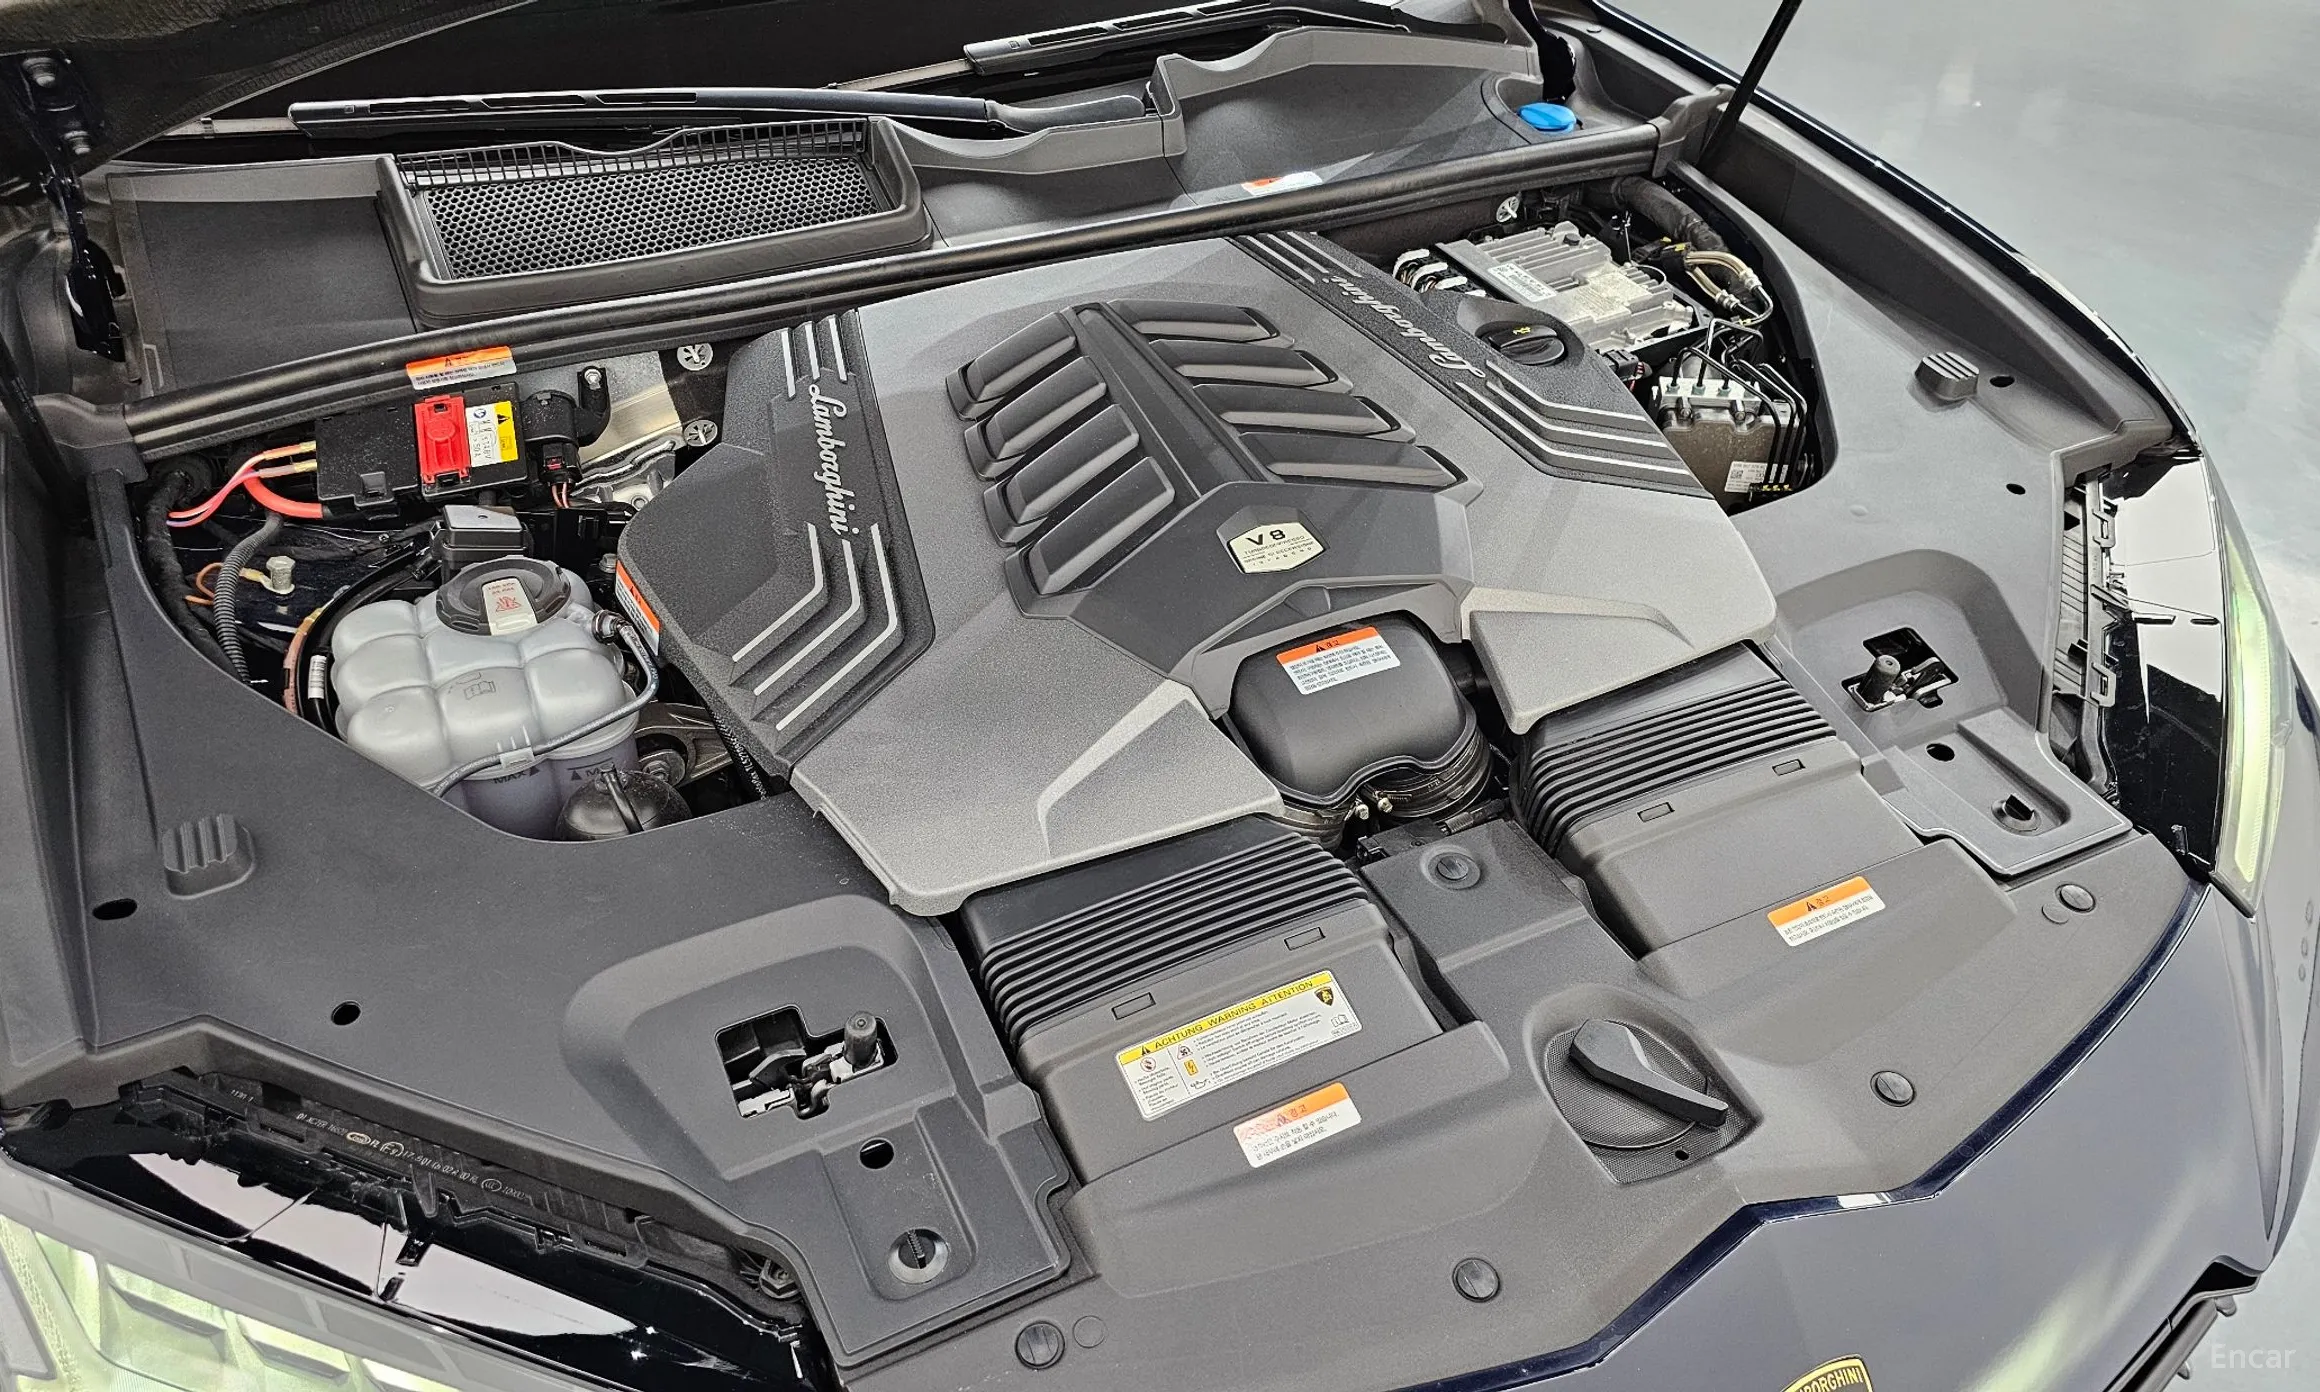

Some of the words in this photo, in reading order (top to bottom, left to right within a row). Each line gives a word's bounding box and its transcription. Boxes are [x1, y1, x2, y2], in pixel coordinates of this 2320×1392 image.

[1321, 275, 1486, 378] Lamborghini
[808, 383, 860, 536] Lamborghini
[493, 770, 527, 784] MAX
[1154, 1024, 1204, 1049] ACHTUNG
[1207, 1003, 1257, 1027] WARNING
[1261, 980, 1314, 1006] ATTENTION
[1800, 1367, 1863, 1392] BORGHINI
